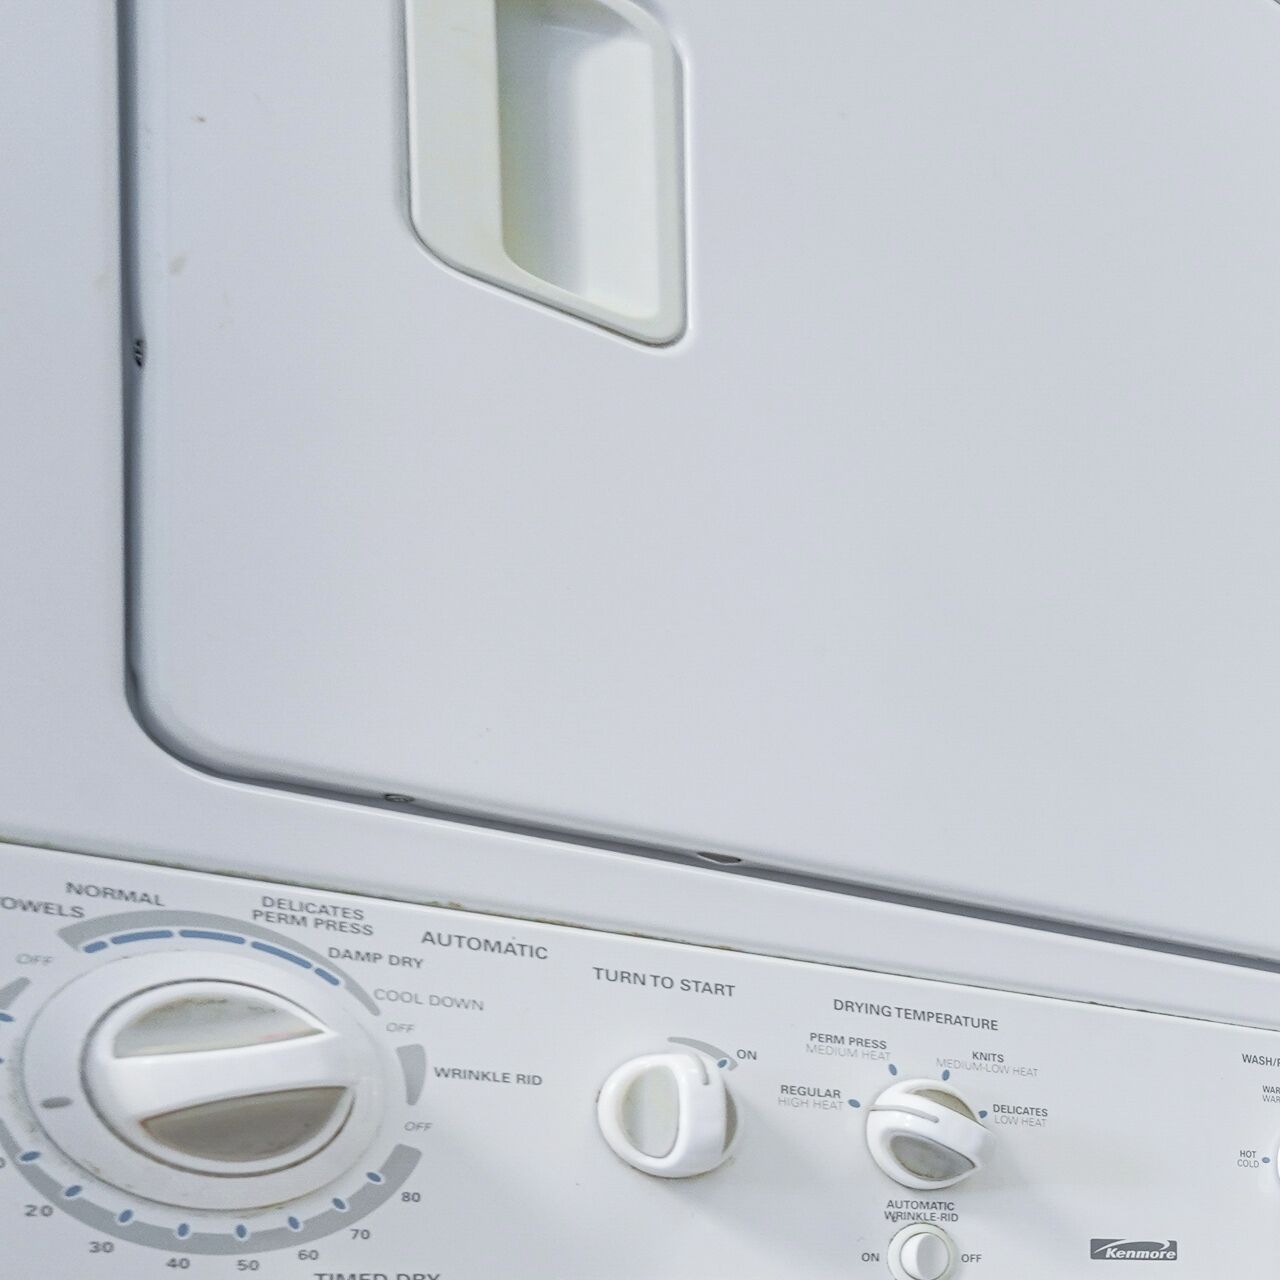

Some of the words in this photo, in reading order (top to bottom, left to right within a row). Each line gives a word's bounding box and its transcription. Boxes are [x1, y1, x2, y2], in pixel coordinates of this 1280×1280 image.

[66, 882, 166, 907] NORMAL
[0, 896, 86, 919] OWELS
[262, 896, 364, 921] DELICATES
[252, 909, 308, 928] PERM
[313, 918, 374, 936] PRESS
[421, 930, 549, 960] AUTOMATIC
[16, 953, 55, 966] OFF
[328, 947, 383, 964] DAMP
[387, 954, 424, 969] DRY
[592, 966, 647, 986] TURN
[649, 974, 674, 989] TO
[680, 979, 736, 997] START
[374, 988, 424, 1005] COOL
[428, 995, 485, 1012] DOWN
[833, 998, 892, 1018] DRYING
[894, 1006, 999, 1031] TEMPERATURE
[386, 1022, 416, 1034] OFF
[810, 1032, 845, 1046] PERM
[848, 1036, 888, 1050] PRESS
[736, 1049, 758, 1061] ON
[805, 1043, 858, 1058] MEDIUM
[861, 1050, 892, 1062] HEAT
[972, 1050, 1004, 1063] KNITS
[935, 1058, 1010, 1074] MEDIUM-LOW
[1012, 1066, 1039, 1078] HEAT
[434, 1066, 511, 1084] WRINKLE
[516, 1074, 543, 1086] RID
[780, 1084, 841, 1099] REGULAR
[778, 1096, 814, 1108] HIGH
[815, 1098, 844, 1111] HEAT
[992, 1104, 1048, 1118] DELICATES
[404, 1121, 433, 1132] OFF
[994, 1114, 1019, 1125] LOW
[1020, 1116, 1048, 1128] HEAT
[1239, 1150, 1256, 1159] HOT
[1237, 1158, 1260, 1169] COLD
[401, 1192, 421, 1203] 80
[24, 1204, 54, 1218] 20
[886, 1200, 956, 1212] AUTOMATIC
[884, 1211, 959, 1223] WRINKLE-RID
[351, 1229, 371, 1240] 70
[88, 1242, 115, 1254] 30
[1105, 1248, 1176, 1260] Kenmore
[298, 1250, 320, 1261] 60
[861, 1252, 880, 1263] ON
[960, 1253, 982, 1264] OFF
[165, 1258, 191, 1270] 40
[237, 1260, 260, 1271] 50
